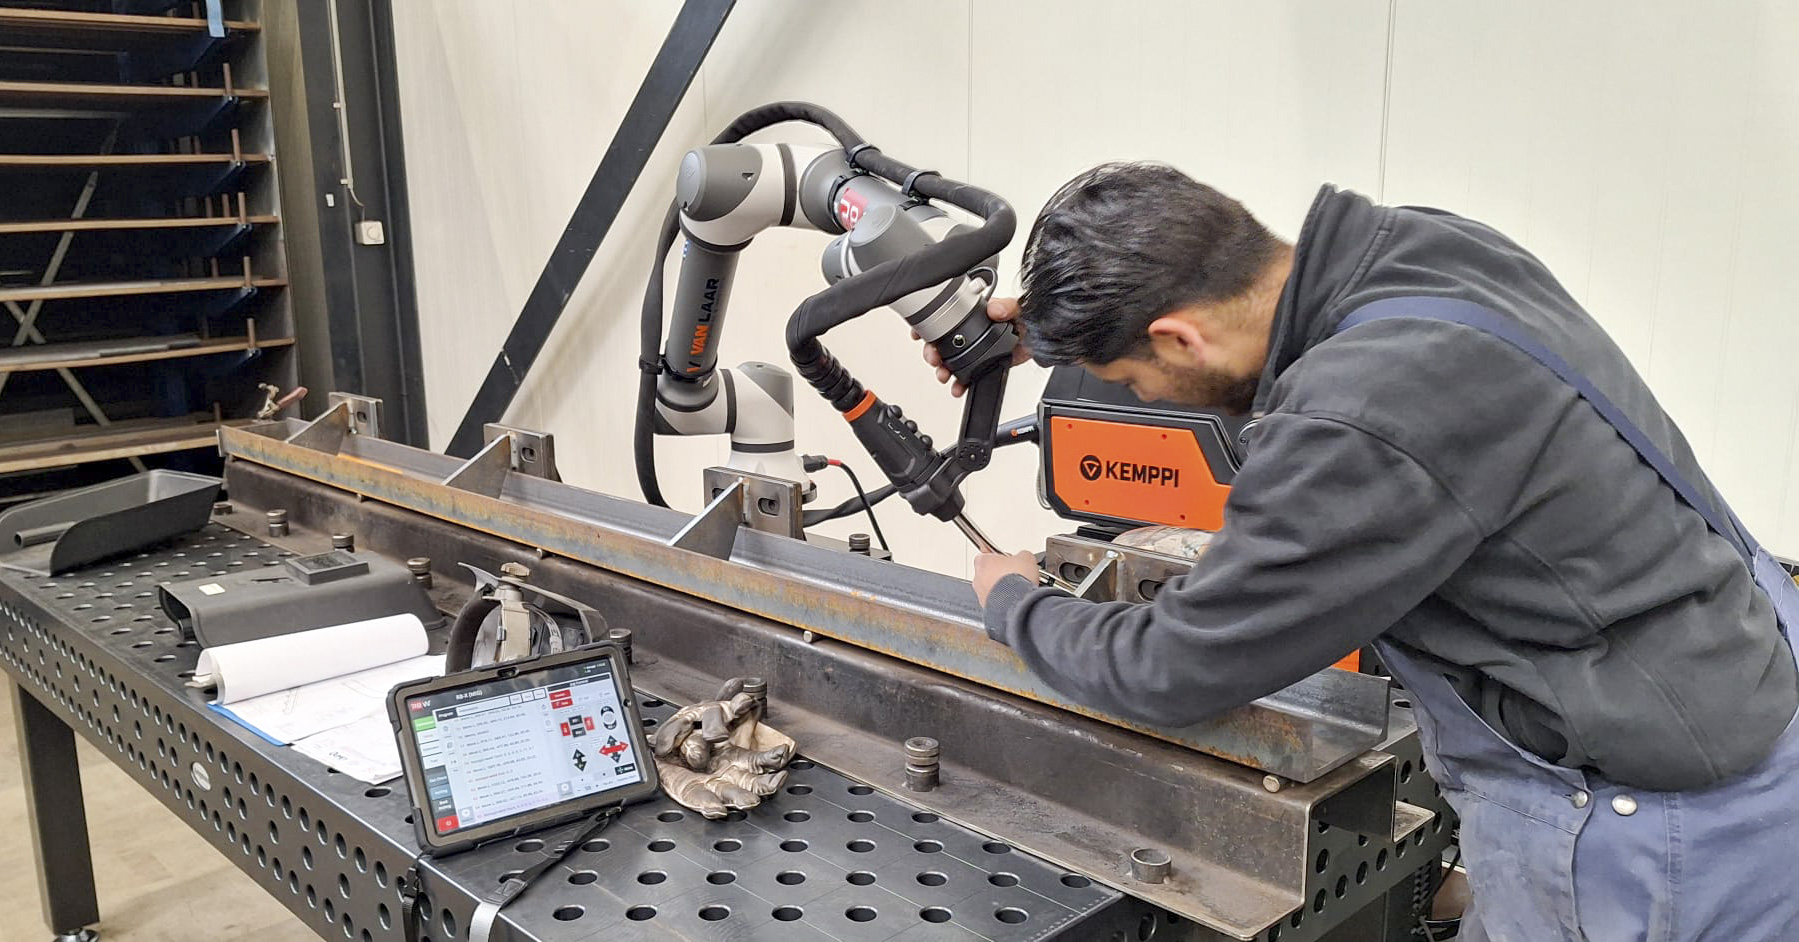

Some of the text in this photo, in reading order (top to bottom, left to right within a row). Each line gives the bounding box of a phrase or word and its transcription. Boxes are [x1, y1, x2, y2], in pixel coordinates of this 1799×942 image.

[698, 278, 720, 323] LAAR
[690, 325, 710, 355] VAN
[1106, 461, 1179, 488] KEMPPI
